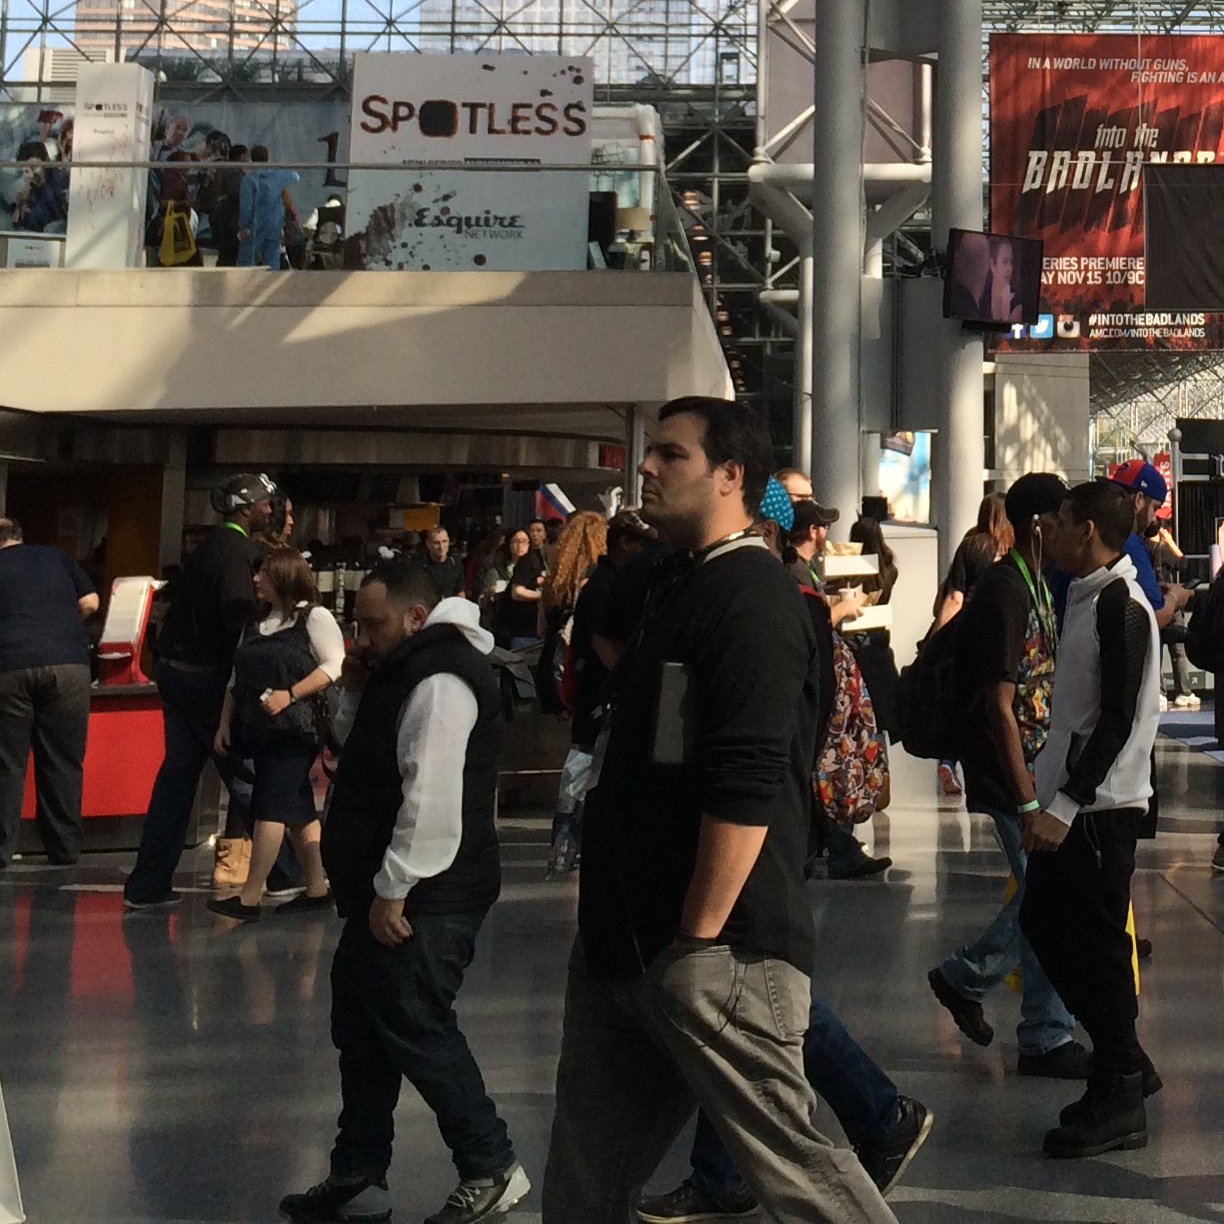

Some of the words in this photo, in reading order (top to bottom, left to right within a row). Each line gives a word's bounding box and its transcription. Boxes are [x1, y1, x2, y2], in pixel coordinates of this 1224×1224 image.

[1028, 57, 1040, 69] IN
[1042, 57, 1051, 69] A
[1053, 58, 1097, 70] WORLD
[1099, 58, 1152, 71] WITHOUT
[1153, 59, 1189, 72] GUNS,
[1130, 71, 1184, 83] FIGHTING
[1187, 72, 1198, 84] IS
[1199, 72, 1217, 84] AN
[1094, 123, 1127, 148] into
[1133, 123, 1159, 147] the
[1021, 151, 1216, 194] BADLA
[408, 207, 526, 235] Esquire
[464, 229, 524, 240] NETWORK
[1042, 257, 1078, 270] ERIES
[1080, 257, 1144, 270] PREMIERE
[1057, 271, 1085, 285] NOV
[1087, 271, 1102, 285] 15
[1105, 271, 1145, 285] 10/9C
[1088, 313, 1205, 326] #INTOTHEBADLANDS
[1089, 327, 1205, 338] AMC.COM/INTOTHEBADLANDS
